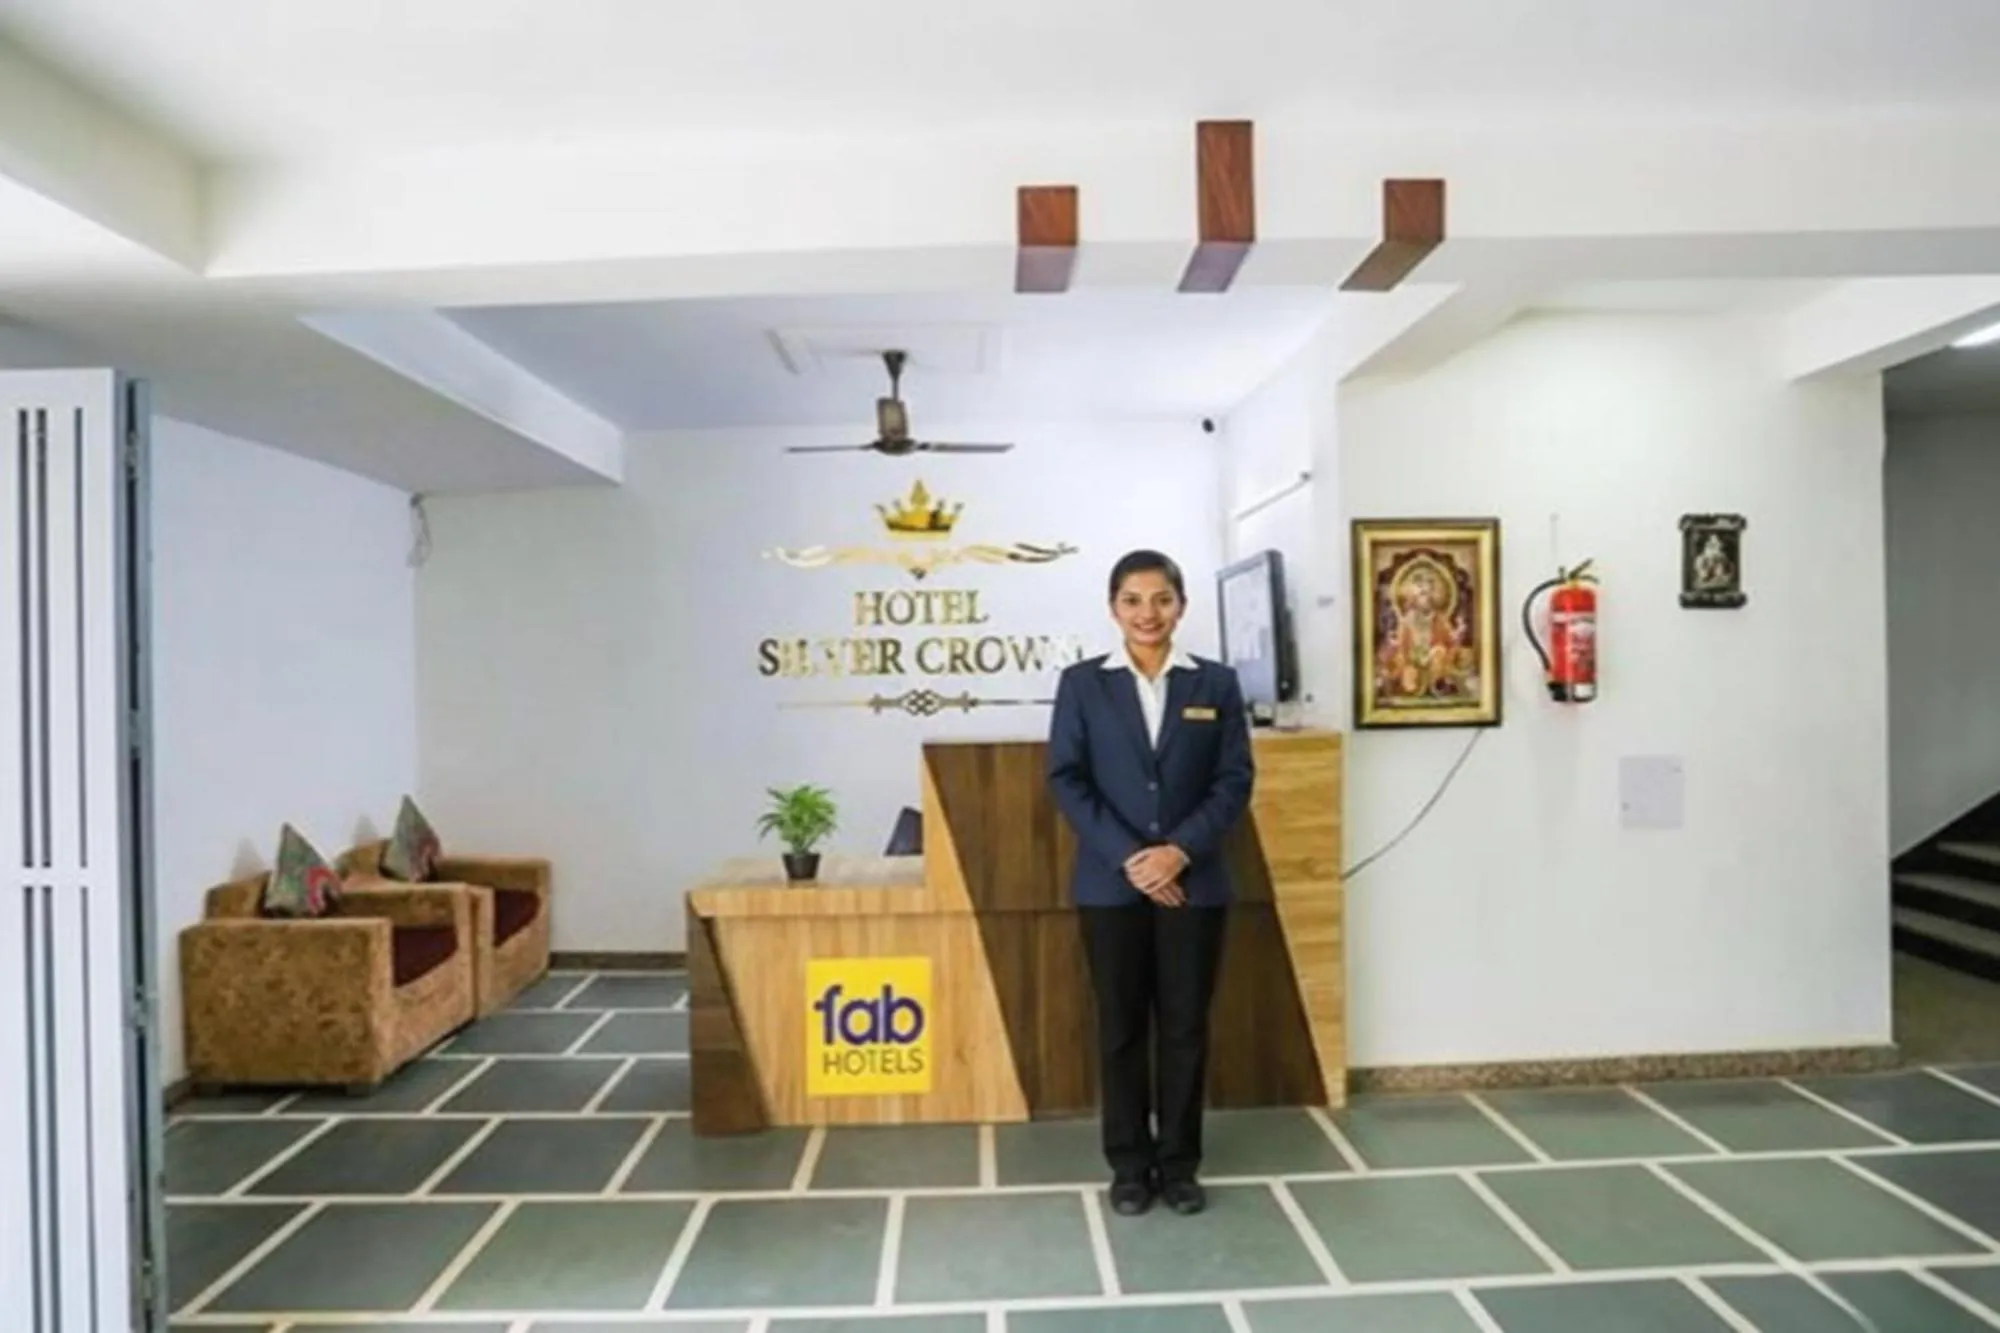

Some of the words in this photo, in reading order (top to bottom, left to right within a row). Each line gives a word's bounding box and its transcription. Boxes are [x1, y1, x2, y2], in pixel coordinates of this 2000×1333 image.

[855, 590, 989, 626] HOTEL
[758, 637, 905, 678] SILVER
[813, 984, 924, 1045] fab
[823, 1048, 924, 1075] HOTELS
